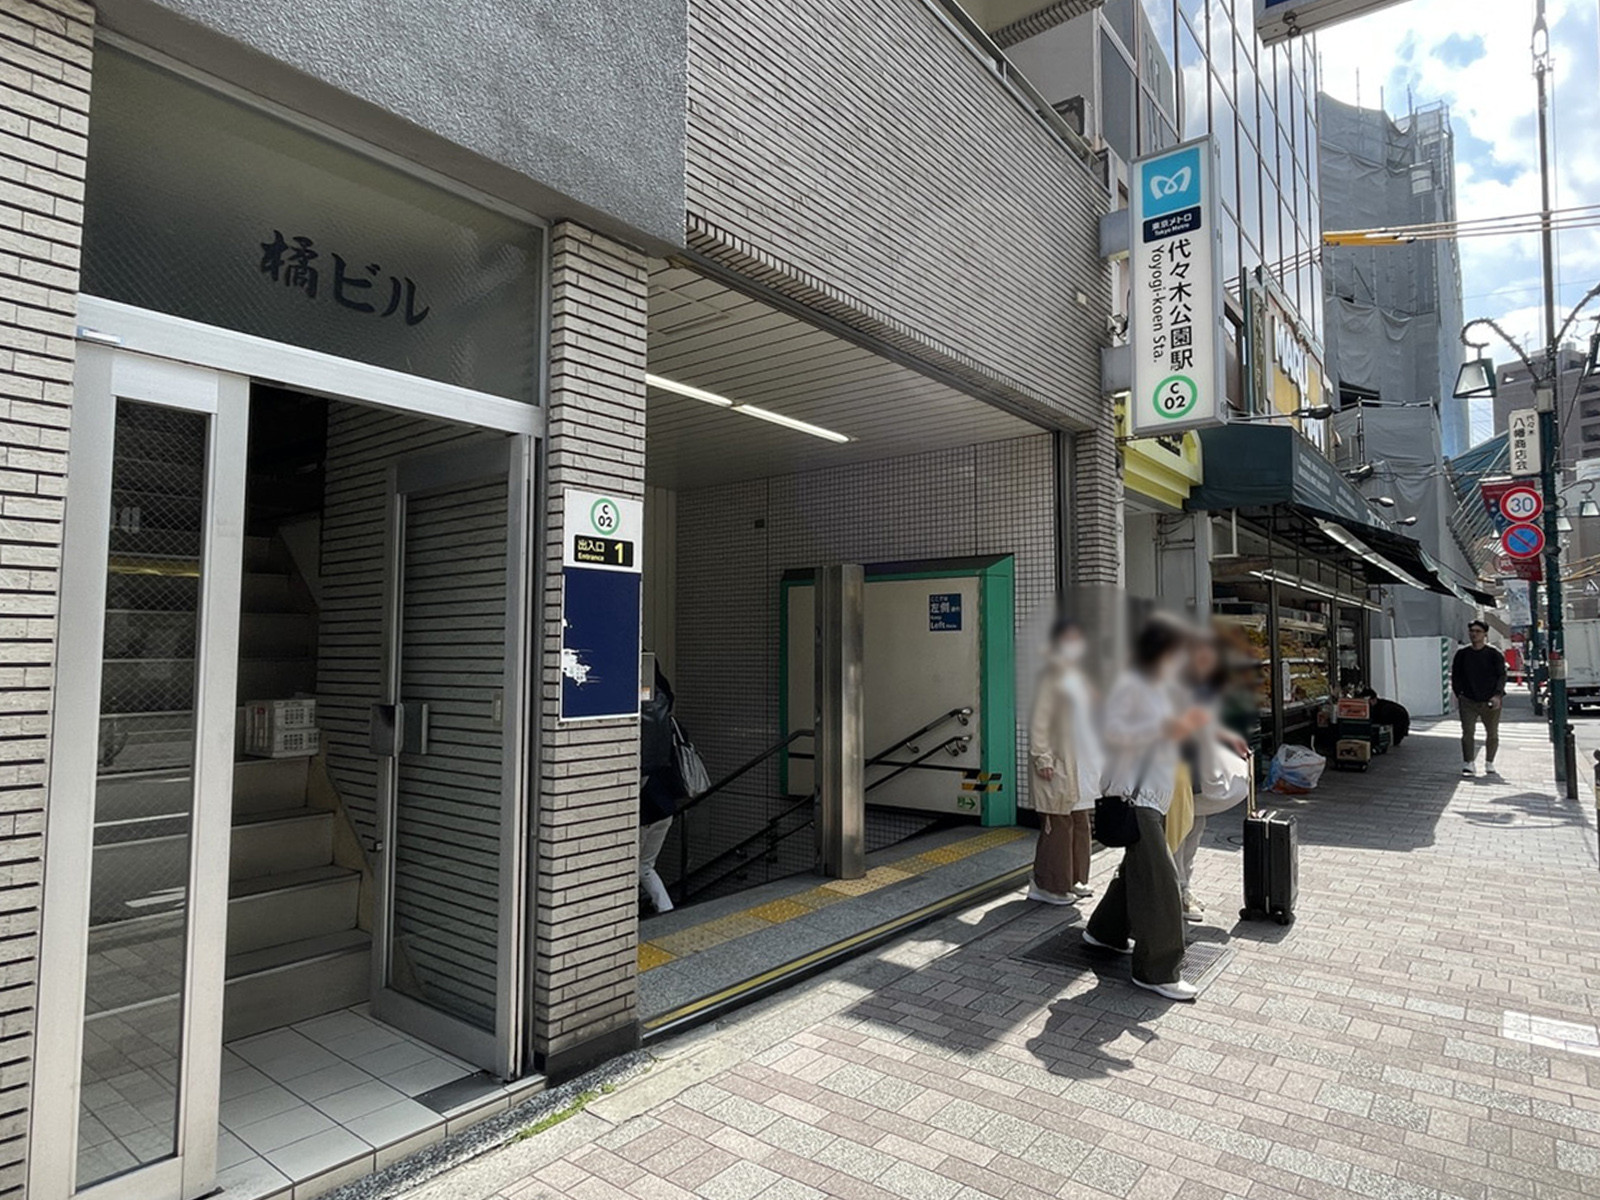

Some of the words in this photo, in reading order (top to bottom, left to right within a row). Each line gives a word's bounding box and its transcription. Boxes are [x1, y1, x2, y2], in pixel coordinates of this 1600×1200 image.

[261, 229, 430, 326] 橘ビル
[1149, 244, 1166, 331] Yoyogi-koen
[1168, 238, 1193, 371] 代々木公園駅
[1152, 336, 1166, 363] Sta.
[1170, 382, 1180, 395] C
[1164, 394, 1186, 411] 02
[602, 504, 609, 515] C
[1510, 497, 1534, 513] 30
[598, 515, 613, 528] 02
[578, 539, 605, 553] 出入口
[614, 542, 623, 563] 1
